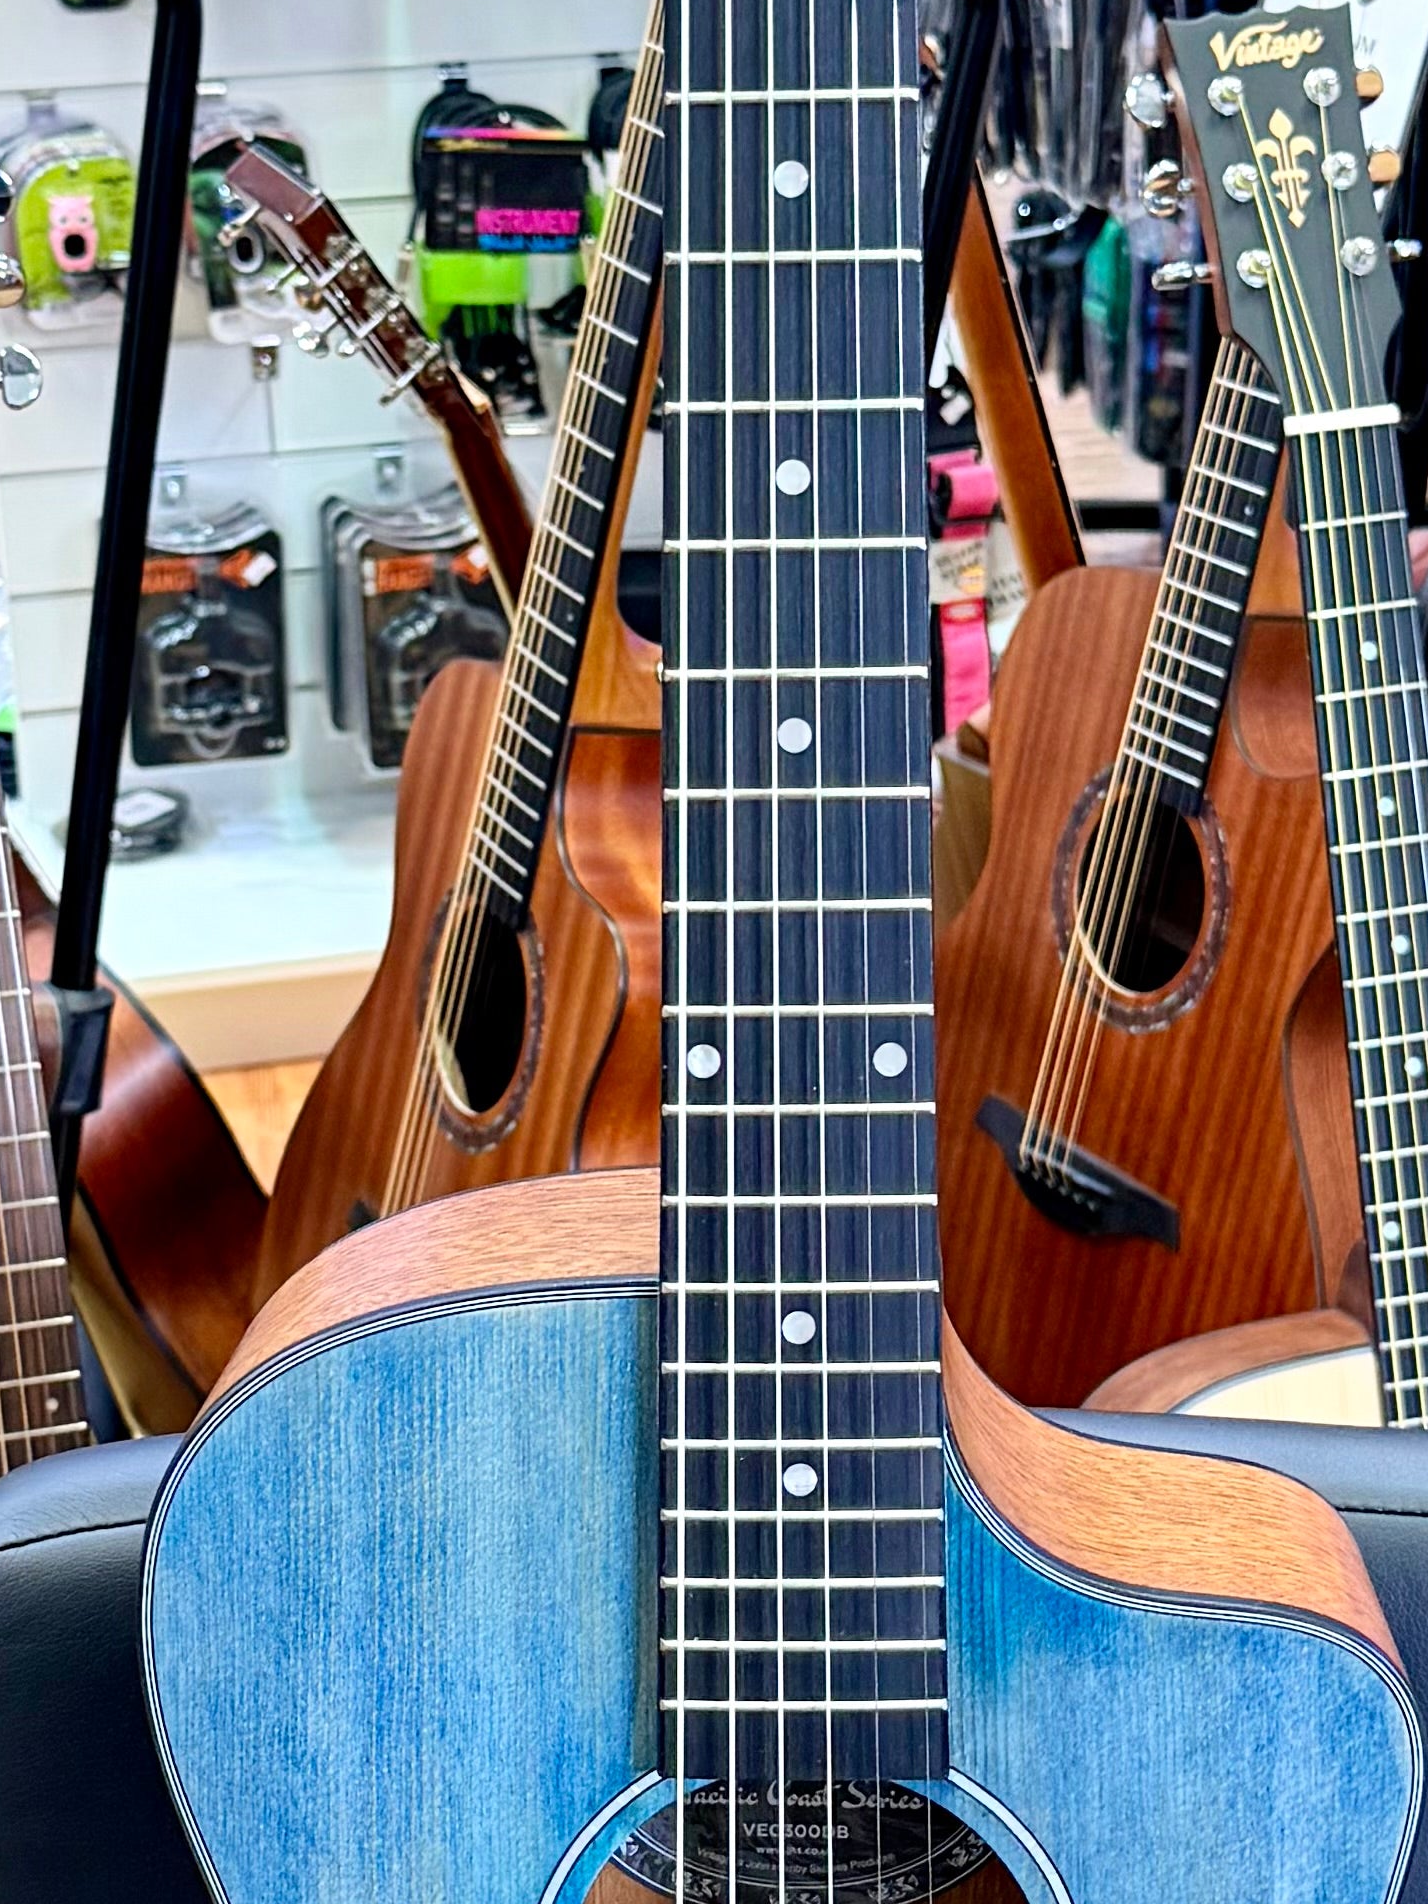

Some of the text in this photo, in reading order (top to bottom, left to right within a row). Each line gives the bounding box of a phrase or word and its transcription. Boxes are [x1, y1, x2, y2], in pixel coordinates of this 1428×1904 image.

[1209, 19, 1326, 72] Vintage
[683, 1785, 759, 1807] aciic
[841, 1779, 925, 1810] Series
